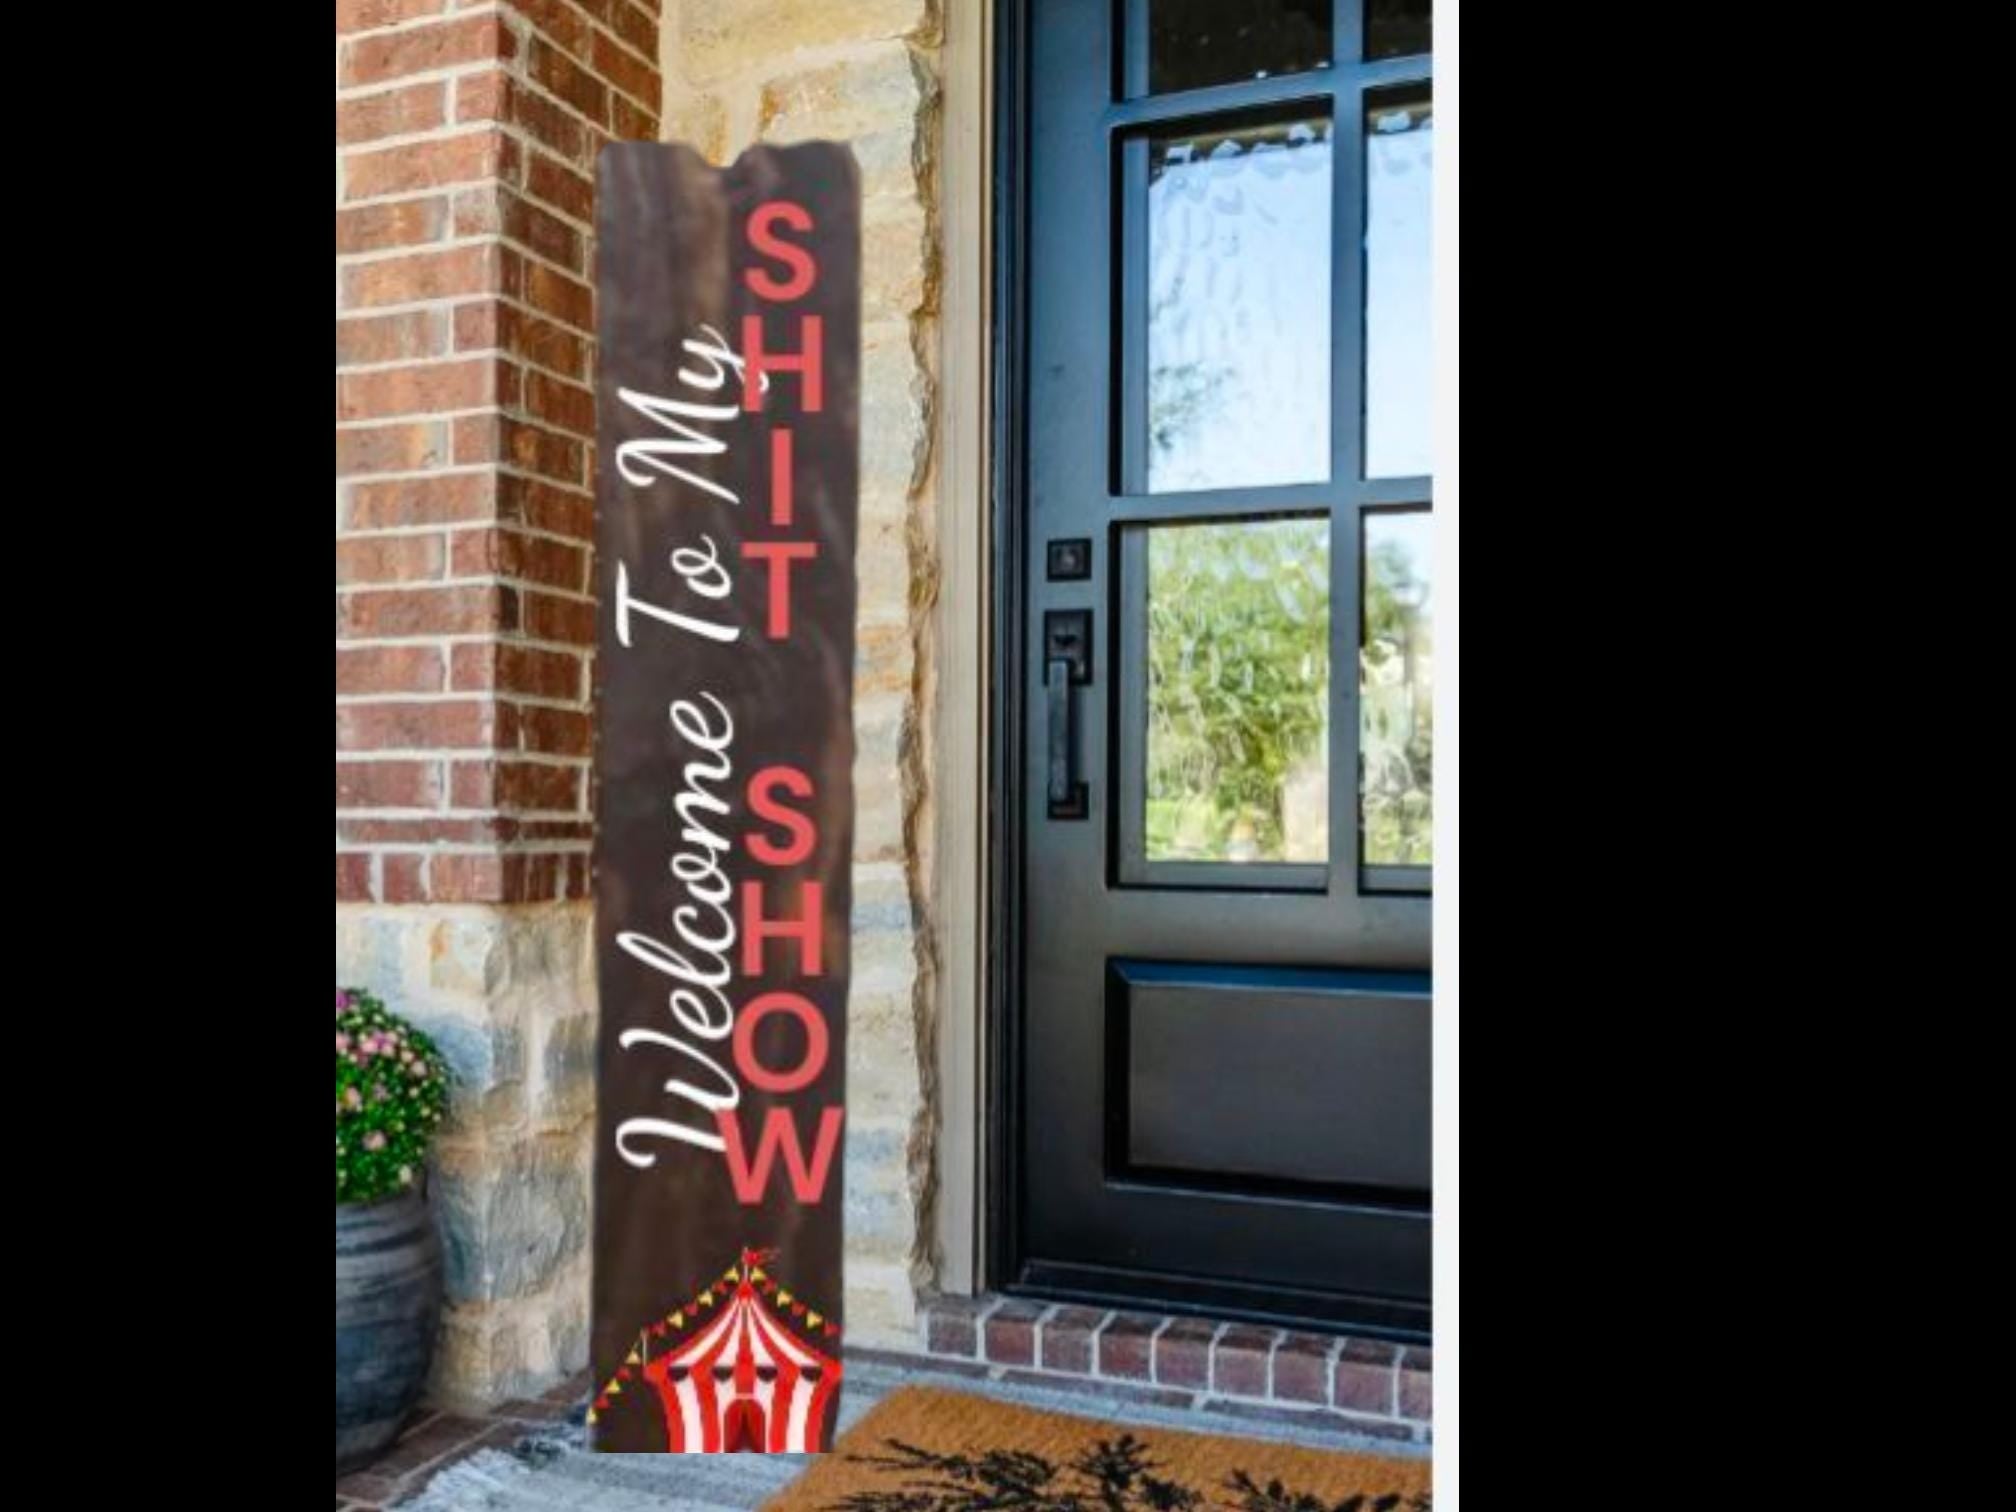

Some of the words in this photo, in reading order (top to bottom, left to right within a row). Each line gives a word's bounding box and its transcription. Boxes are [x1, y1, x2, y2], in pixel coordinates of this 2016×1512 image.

[616, 324, 770, 504] My
[616, 534, 740, 648] To
[741, 201, 823, 638] SHIT
[616, 691, 740, 1168] Welcome
[714, 766, 843, 1204] SHOW
